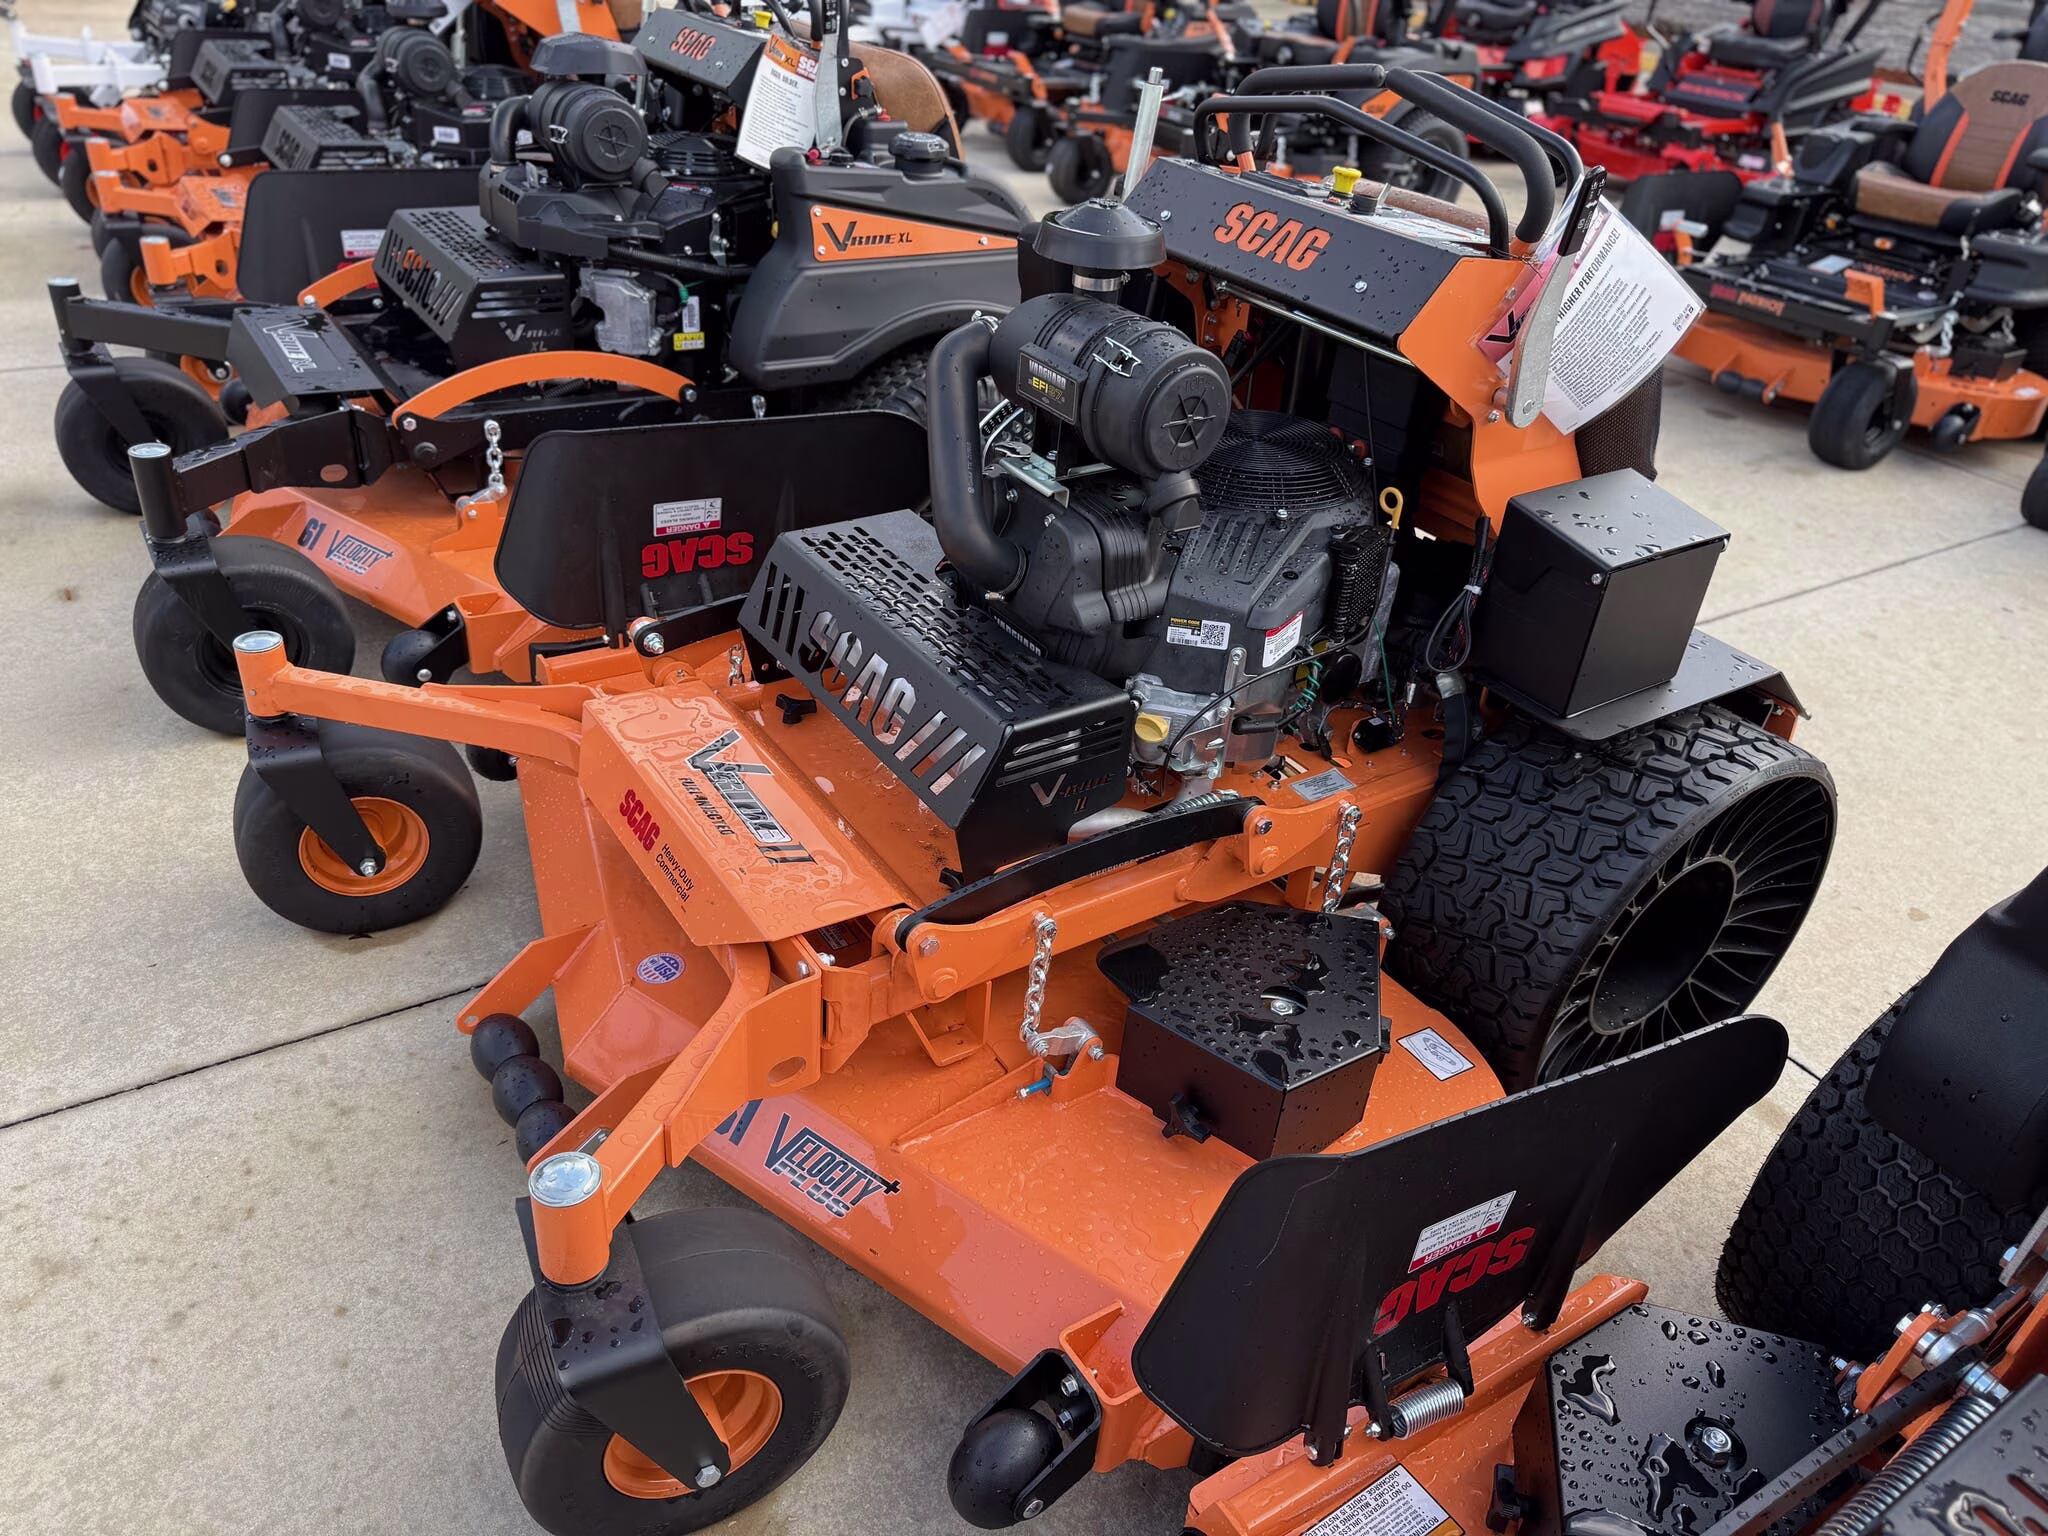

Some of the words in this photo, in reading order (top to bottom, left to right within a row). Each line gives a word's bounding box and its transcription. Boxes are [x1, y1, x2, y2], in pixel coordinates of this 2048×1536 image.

[671, 27, 717, 61] SCAG
[1990, 90, 2029, 107] SCAG
[898, 232, 913, 243] XL
[1213, 202, 1332, 272] SCAG
[1555, 286, 1582, 320] HIGHER
[1577, 226, 1621, 290] PERFORMANCE!
[297, 517, 327, 551] 61
[665, 522, 701, 533] DANGER
[641, 531, 754, 578] SCAG
[798, 610, 917, 746] SCAG
[619, 789, 661, 852] SCAG
[678, 777, 736, 836] FUEL-INJECTED
[655, 853, 690, 903] Commercial
[661, 843, 695, 892] Heavy-Duty
[653, 962, 678, 981] USA
[714, 1098, 764, 1147] 1
[771, 1160, 851, 1219] PLUS
[1423, 1233, 1472, 1263] DANGER
[1372, 1226, 1537, 1337] SCAG
[1365, 1469, 1399, 1496] DISCHARGE
[1368, 1479, 1400, 1505] CATCHER,
[1387, 1487, 1403, 1501] NOT
[1400, 1480, 1412, 1491] DO
[1338, 1507, 1347, 1516] IS
[1338, 1500, 1372, 1527] MULCHING
[1345, 1493, 1368, 1512] CHUTE
[1360, 1497, 1389, 1520] OPERATE
[1328, 1522, 1341, 1534] KIT
[1336, 1516, 1362, 1536] UNLESS
